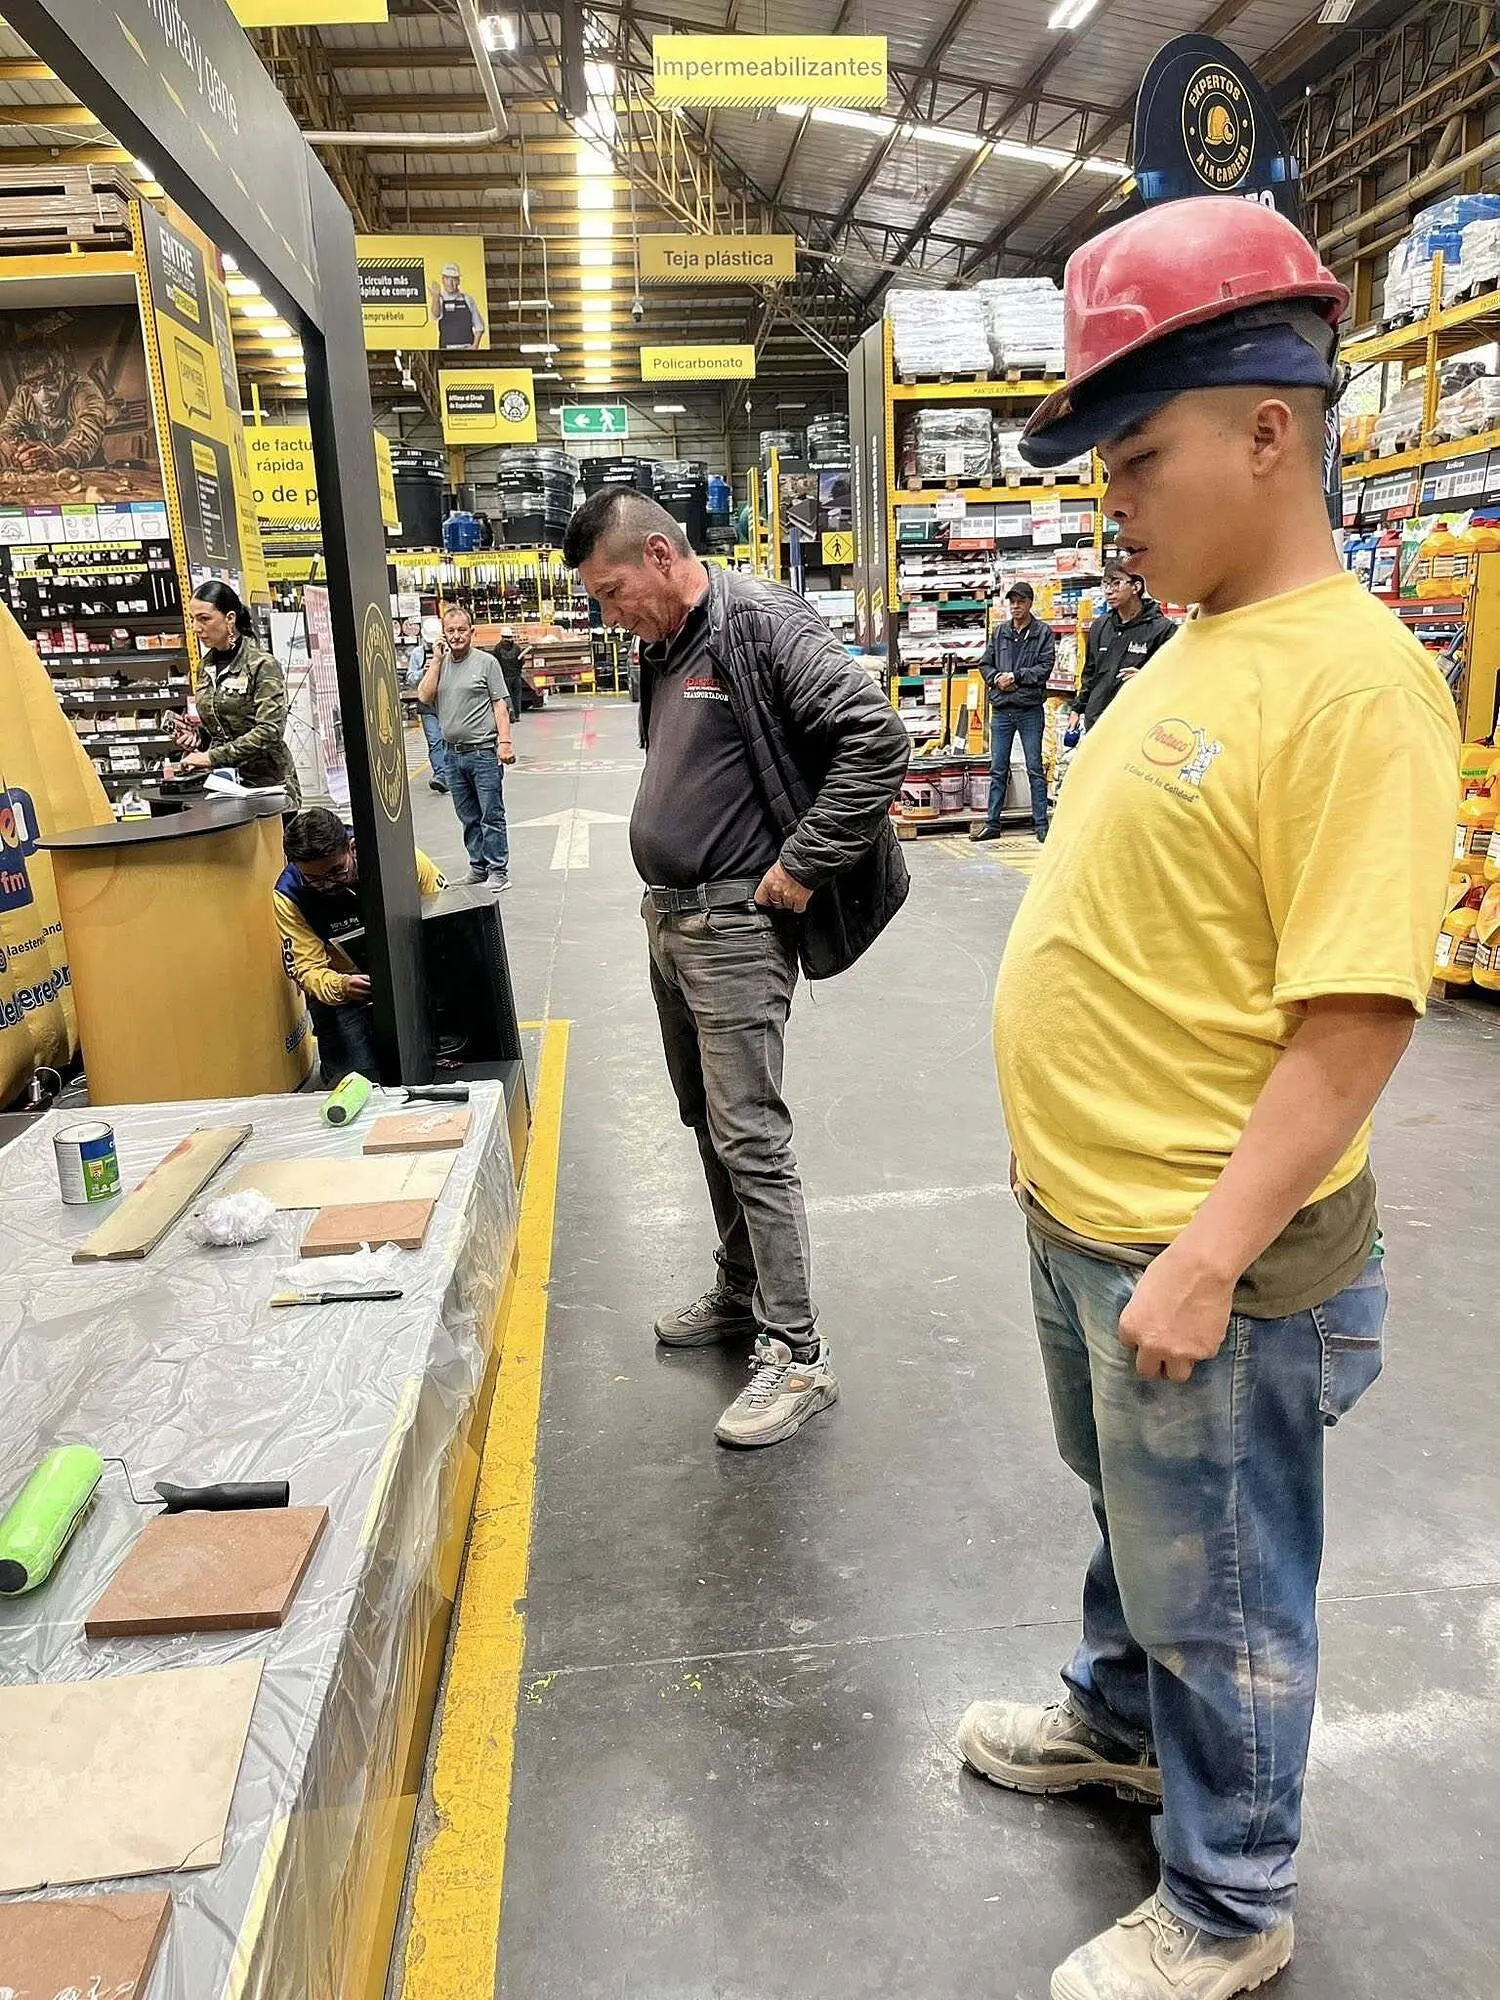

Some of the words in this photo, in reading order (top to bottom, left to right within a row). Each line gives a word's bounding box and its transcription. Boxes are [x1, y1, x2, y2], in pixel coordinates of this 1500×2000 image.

[656, 56, 882, 80] Impermeabilizantes
[205, 55, 239, 135] gane
[1188, 74, 1241, 109] EXPERTOS
[1196, 152, 1204, 165] A
[1203, 163, 1215, 180] LA
[1216, 144, 1250, 183] CARRERA
[159, 225, 195, 280] ENTRE
[663, 250, 699, 270] Teja
[705, 250, 774, 270] plástica
[364, 275, 392, 286] circuito
[393, 275, 409, 286] más
[360, 285, 381, 299] ápido
[381, 286, 391, 297] de
[391, 287, 419, 299] compra
[652, 357, 744, 370] Policarbonato
[251, 439, 270, 452] de
[256, 457, 305, 474] rápida
[271, 485, 298, 503] de
[0, 870, 26, 895] fm
